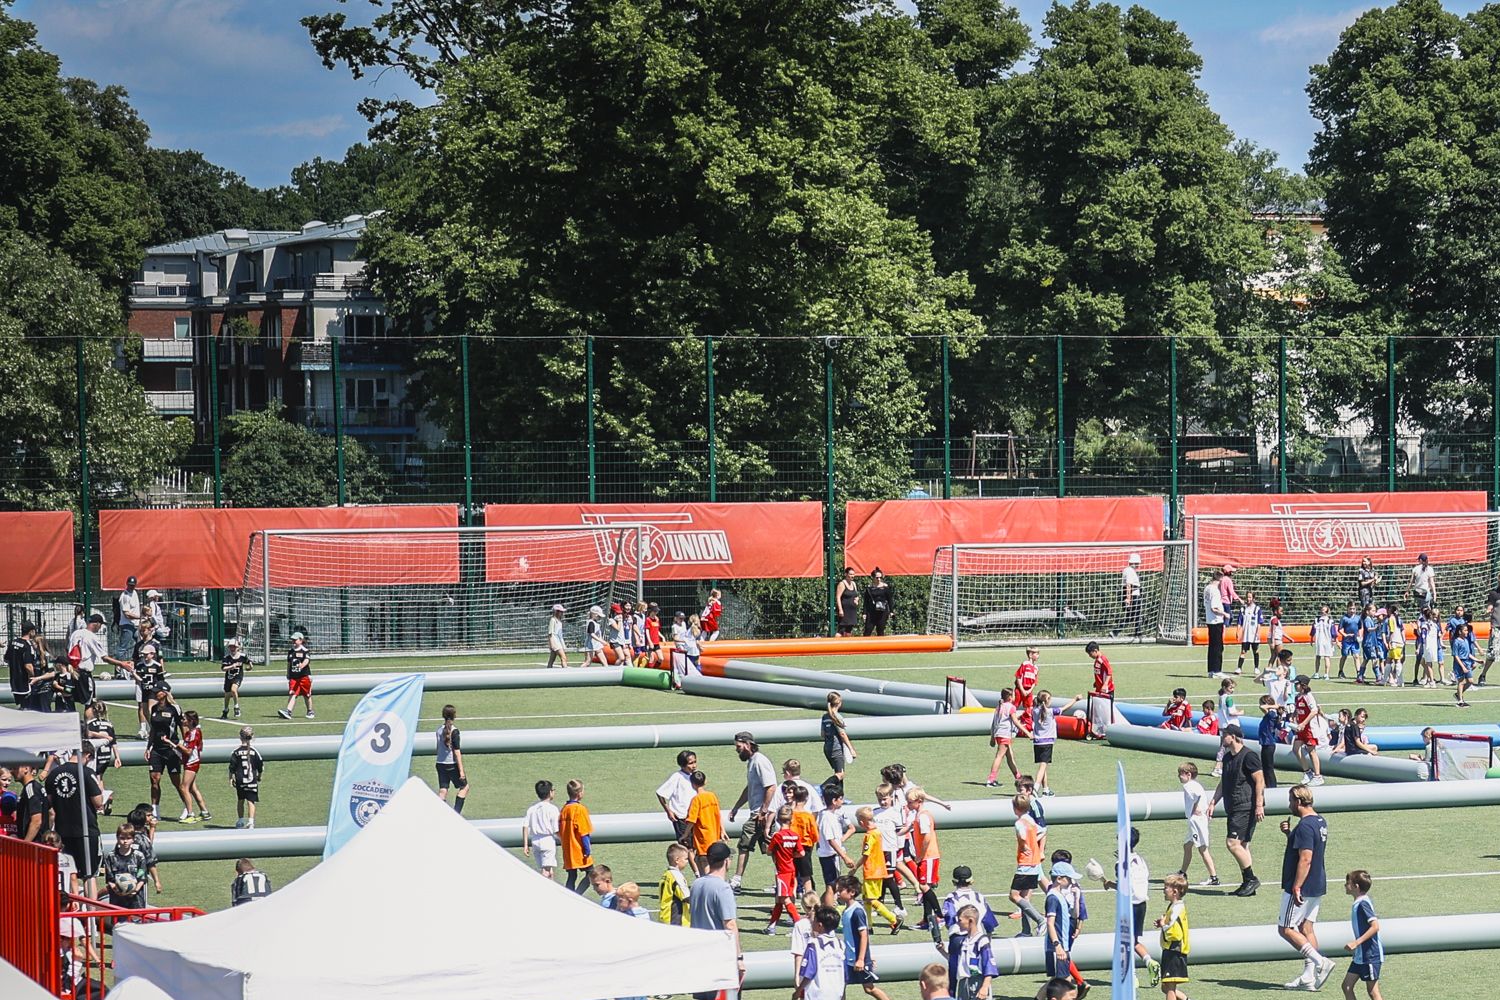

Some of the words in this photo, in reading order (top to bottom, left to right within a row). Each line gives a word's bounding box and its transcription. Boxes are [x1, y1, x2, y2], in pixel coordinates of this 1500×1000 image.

[667, 532, 730, 561] UNION
[1346, 521, 1402, 548] UNION
[370, 722, 392, 754] 3
[352, 783, 395, 795] ZOCCADEMY
[243, 872, 266, 894] 17
